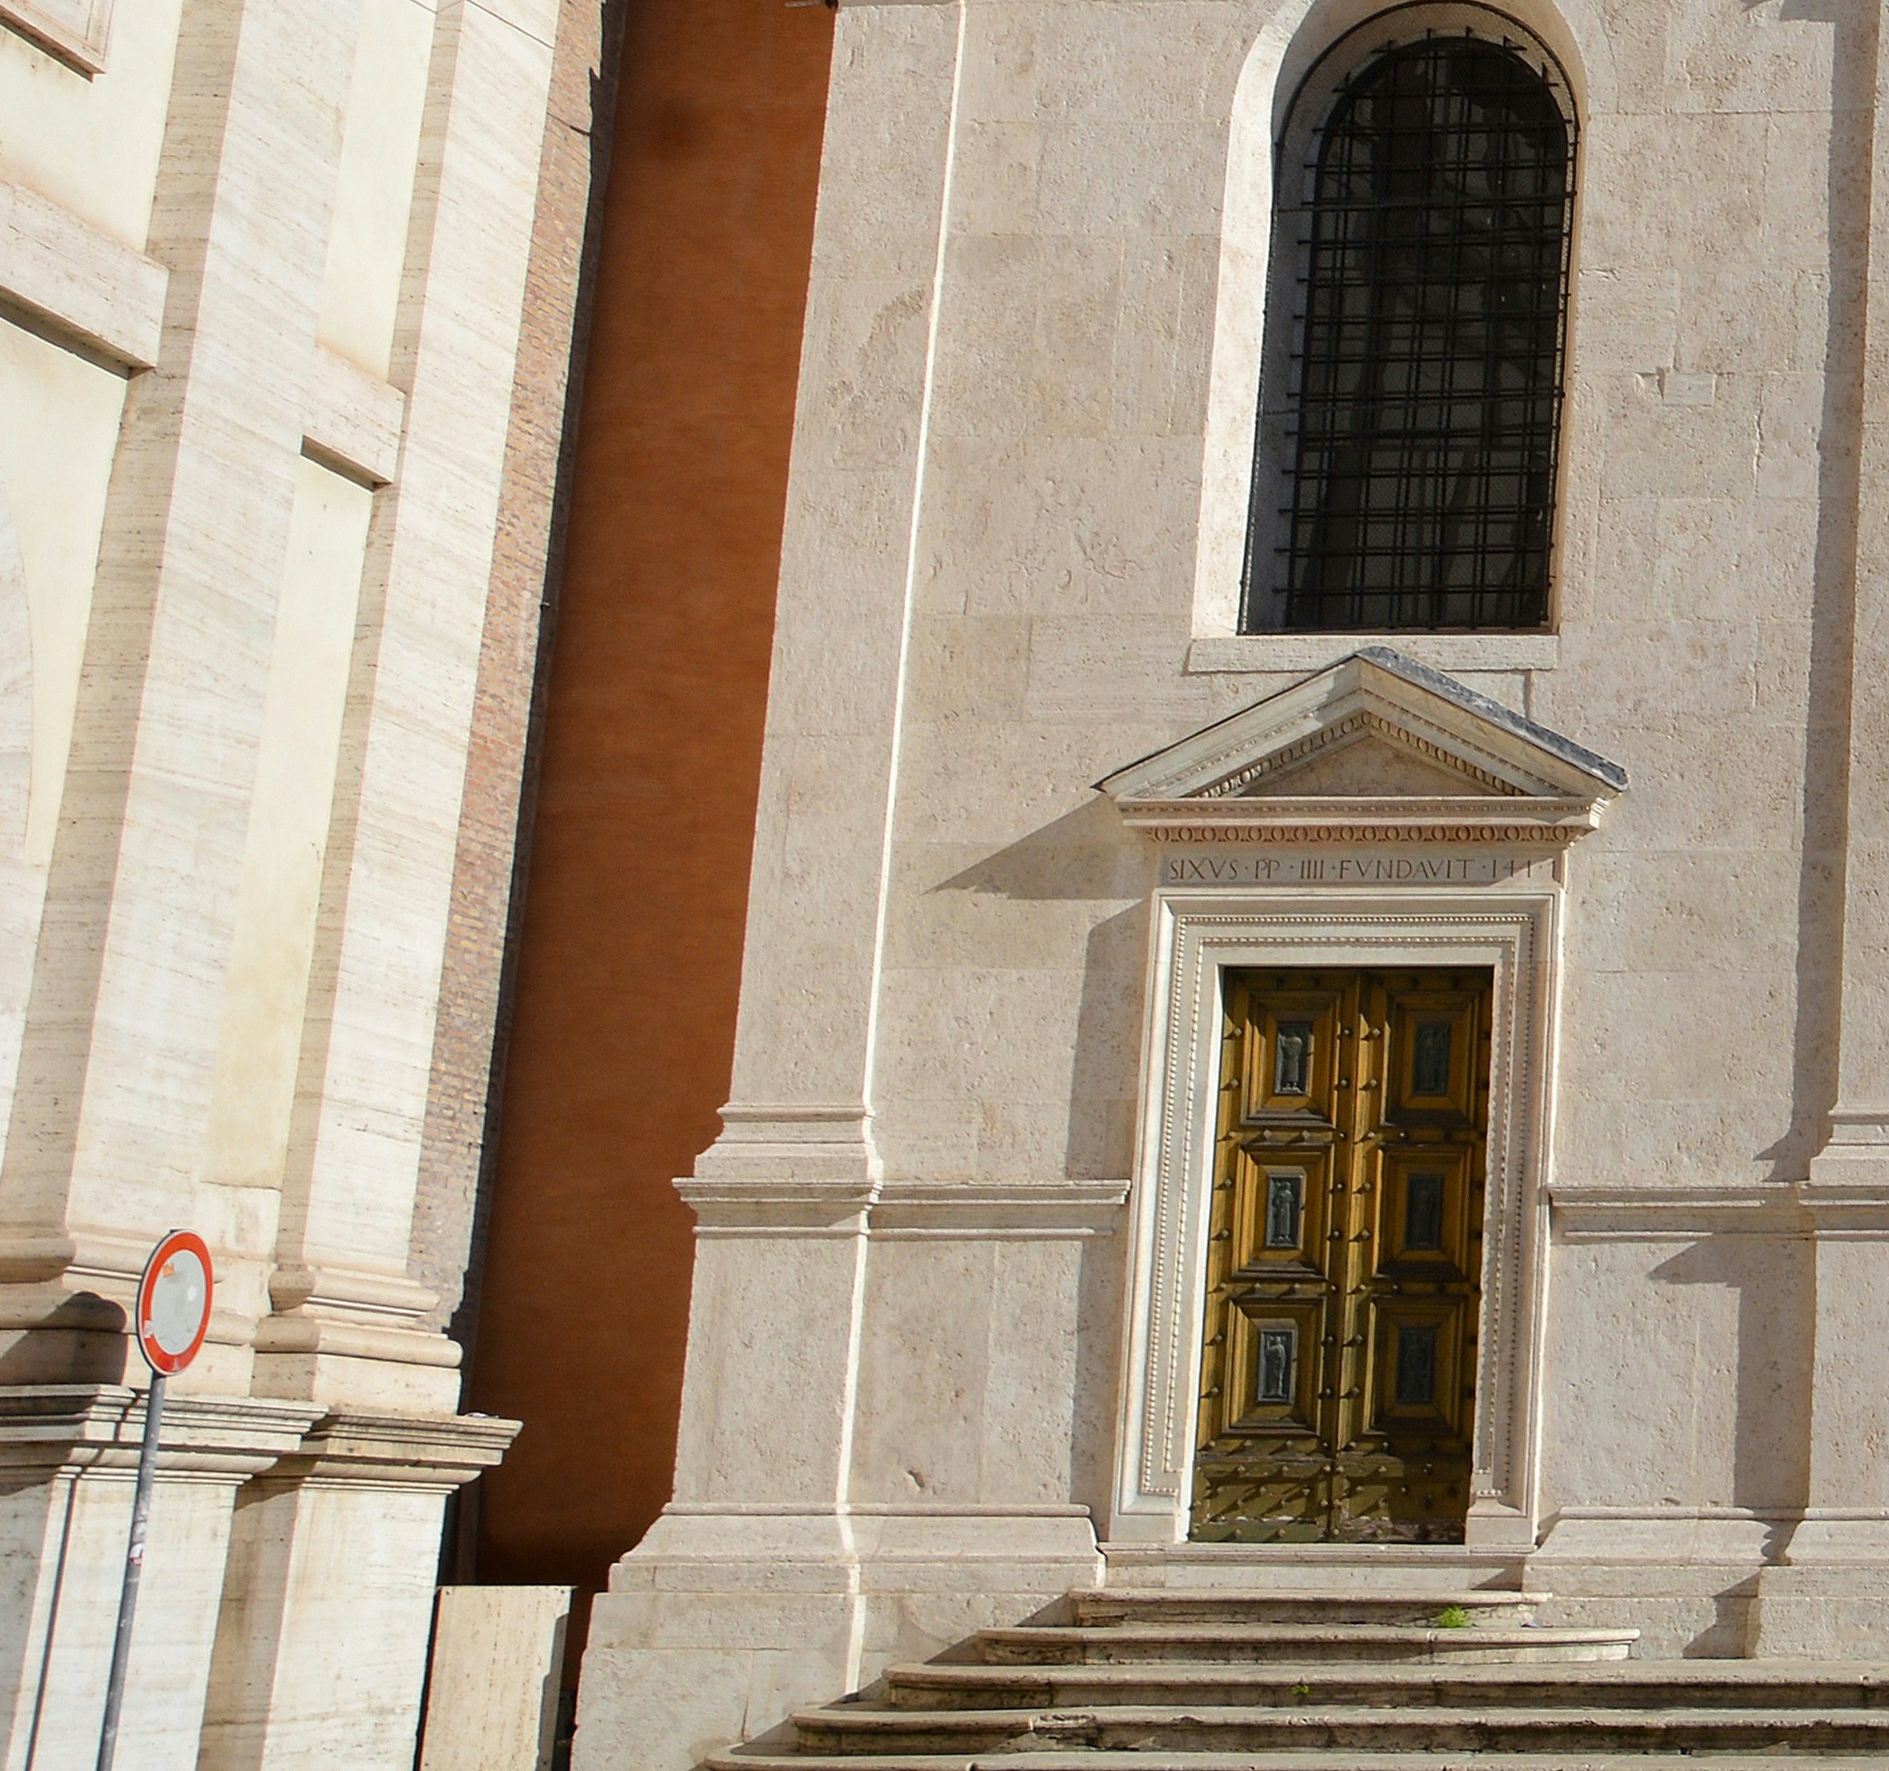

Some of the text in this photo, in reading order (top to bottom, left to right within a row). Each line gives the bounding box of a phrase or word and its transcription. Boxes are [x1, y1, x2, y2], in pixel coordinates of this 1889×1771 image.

[1169, 857, 1239, 880] SIXVS
[1255, 856, 1281, 879] PP
[1338, 858, 1475, 880] FVNDAVIT
